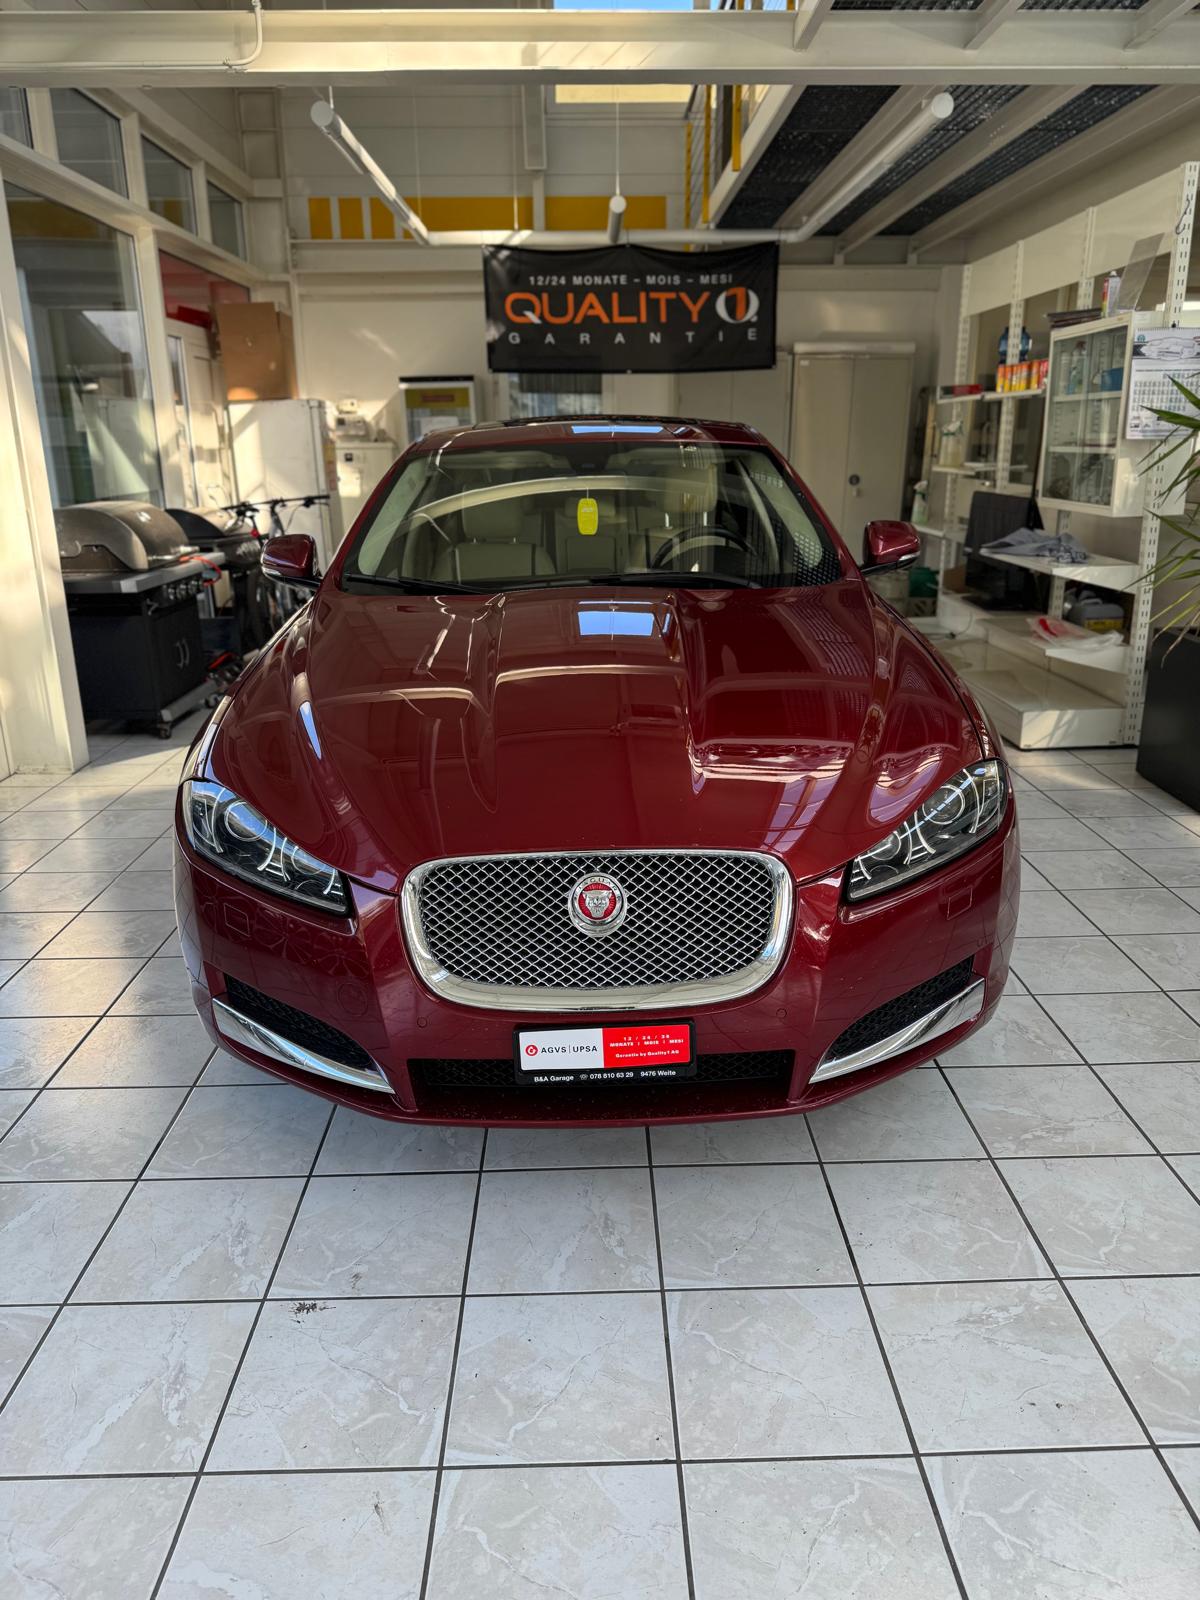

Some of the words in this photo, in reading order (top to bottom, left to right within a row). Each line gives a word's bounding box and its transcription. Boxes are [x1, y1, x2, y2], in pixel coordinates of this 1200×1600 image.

[529, 275, 566, 286] 12/24
[572, 274, 628, 286] MONATE
[646, 274, 681, 285] MOIS
[700, 273, 733, 285] MESI
[504, 291, 711, 324] QUALITY
[508, 327, 758, 345] GARANTIE
[541, 1046, 567, 1054] AGVS
[572, 1045, 598, 1053] UPSA
